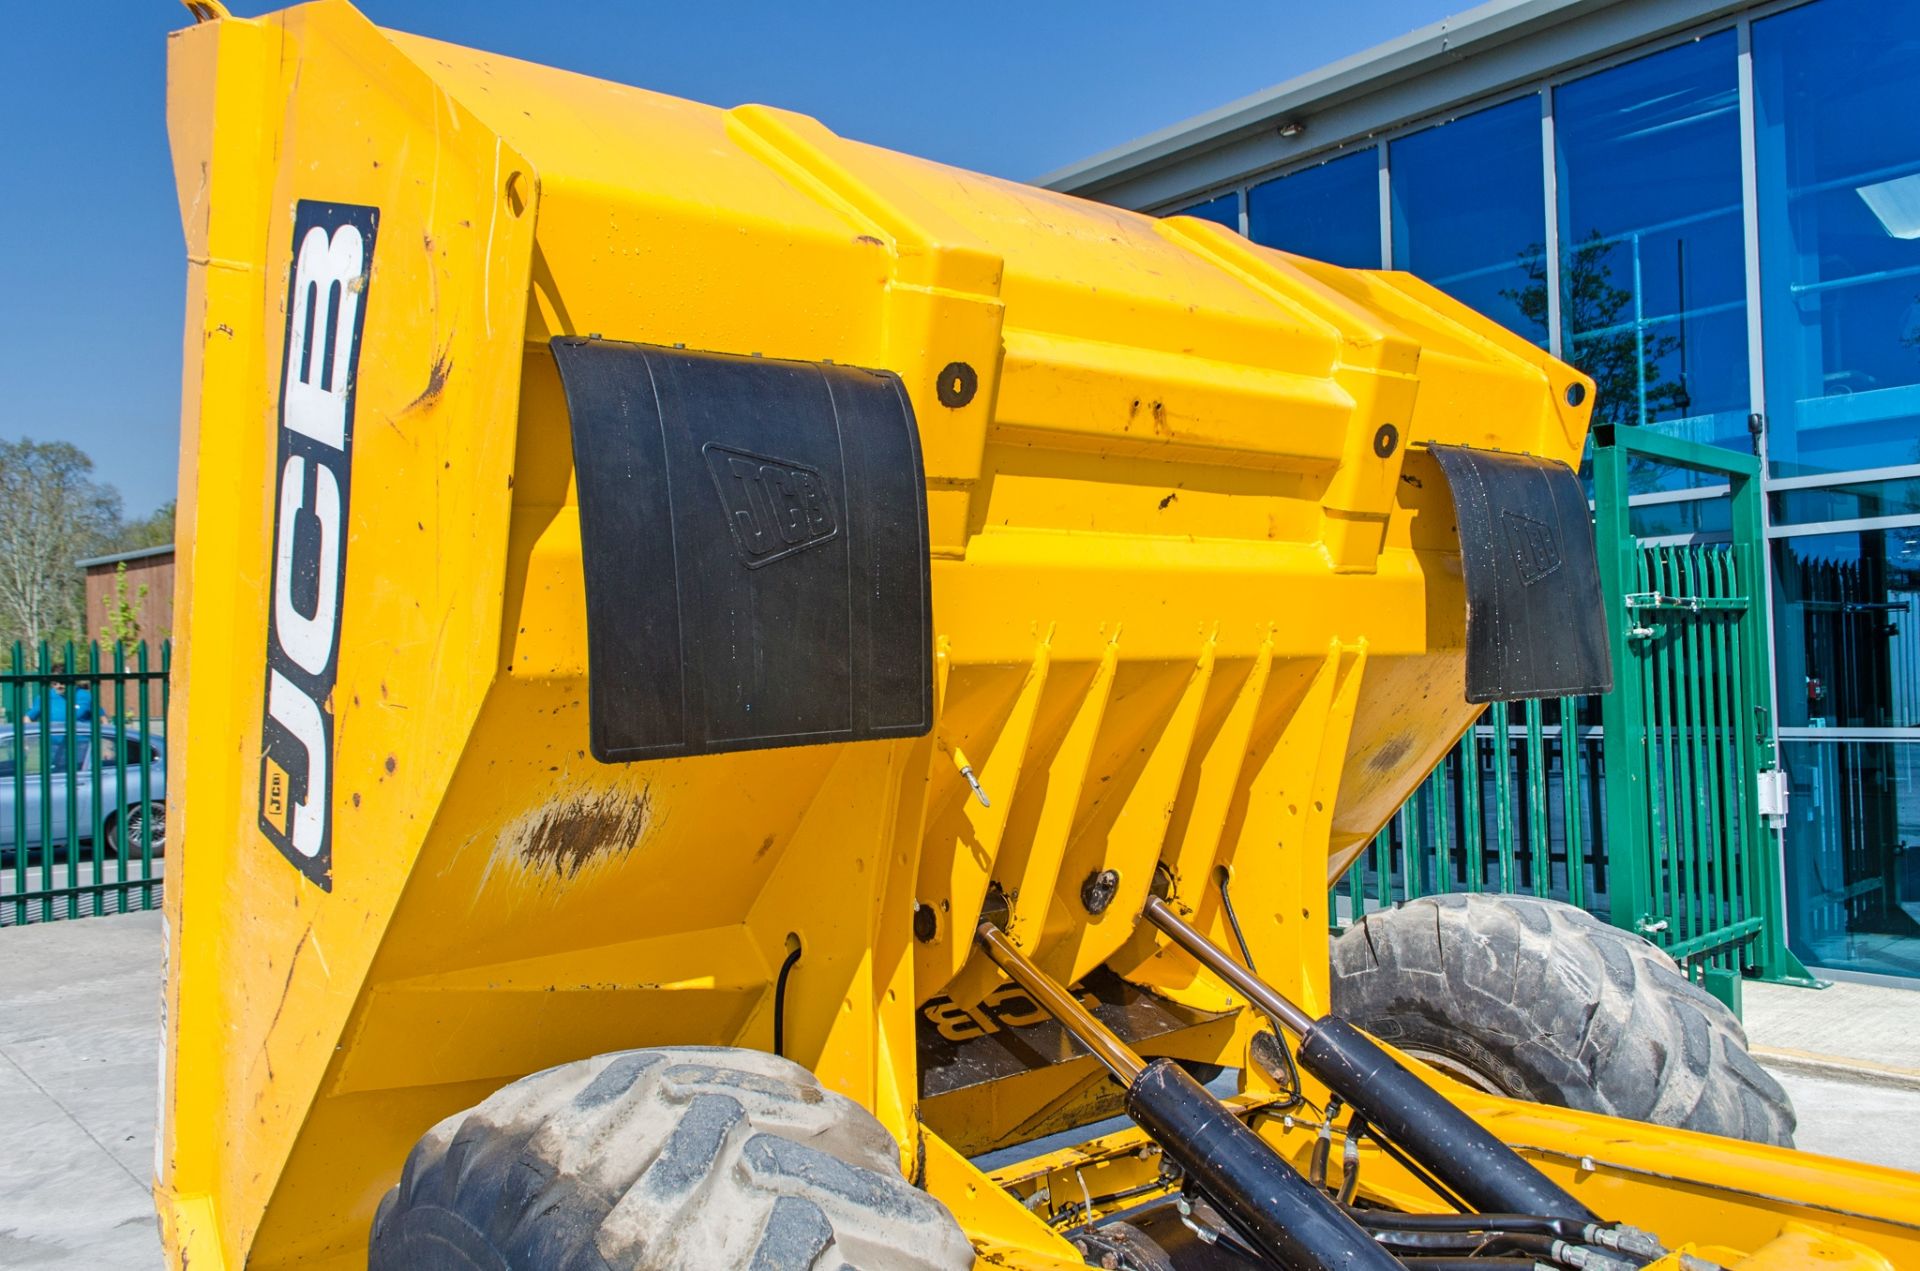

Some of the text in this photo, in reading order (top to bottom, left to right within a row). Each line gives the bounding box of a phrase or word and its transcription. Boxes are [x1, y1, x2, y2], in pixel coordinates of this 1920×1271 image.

[268, 224, 364, 858] JCB
[728, 458, 832, 555] JCB
[270, 777, 281, 811] JCB
